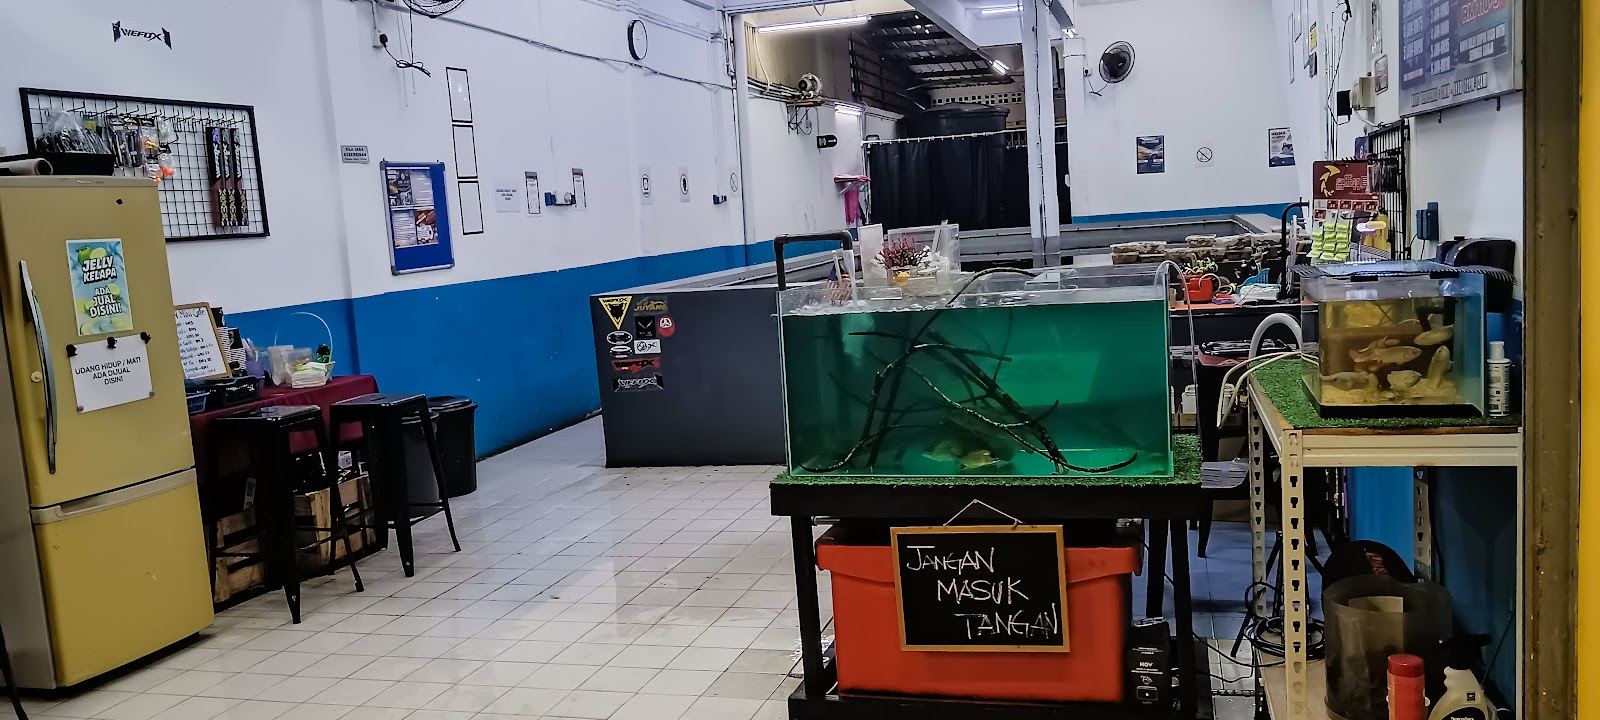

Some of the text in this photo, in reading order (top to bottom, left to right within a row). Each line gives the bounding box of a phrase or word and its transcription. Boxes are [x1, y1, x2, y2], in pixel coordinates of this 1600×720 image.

[82, 255, 114, 272] JELLY
[83, 267, 117, 284] KELAPA
[95, 286, 110, 296] ADA
[93, 294, 116, 306] JUAL
[89, 303, 122, 318] DISINI!
[74, 364, 101, 375] UDANG
[101, 360, 122, 370] HIDUP
[126, 356, 142, 365] MATI
[92, 367, 131, 380] ADA DIJUAL
[104, 376, 124, 386] DISINI
[906, 545, 996, 576] JANGAN
[937, 576, 1030, 605] MASUK
[953, 602, 1059, 640] TANGAN
